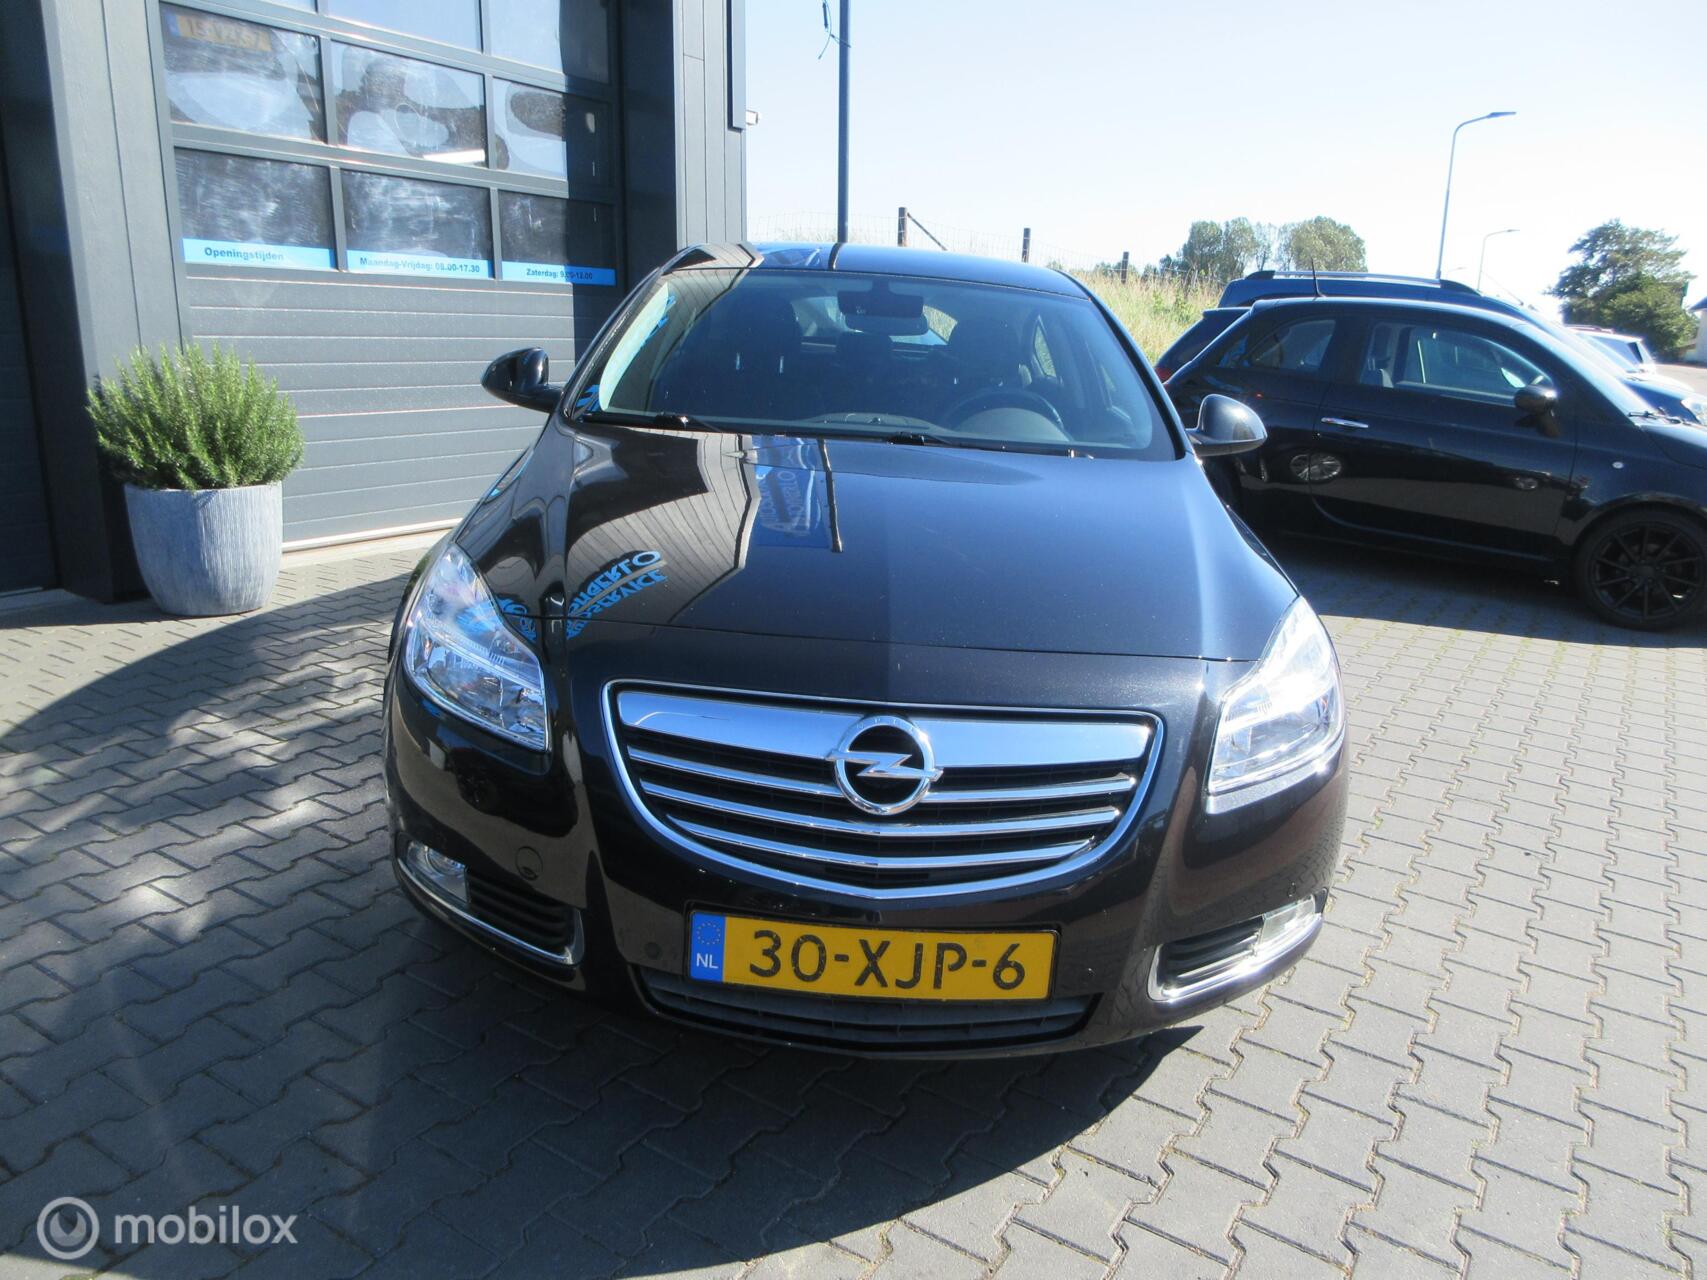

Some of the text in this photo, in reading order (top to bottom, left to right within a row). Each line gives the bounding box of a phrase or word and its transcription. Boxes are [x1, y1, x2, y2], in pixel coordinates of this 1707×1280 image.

[204, 246, 285, 262] Openingstijden
[526, 268, 559, 279] Zaterdag:
[695, 952, 719, 970] NL
[748, 929, 1026, 991] 30-XJP-6
